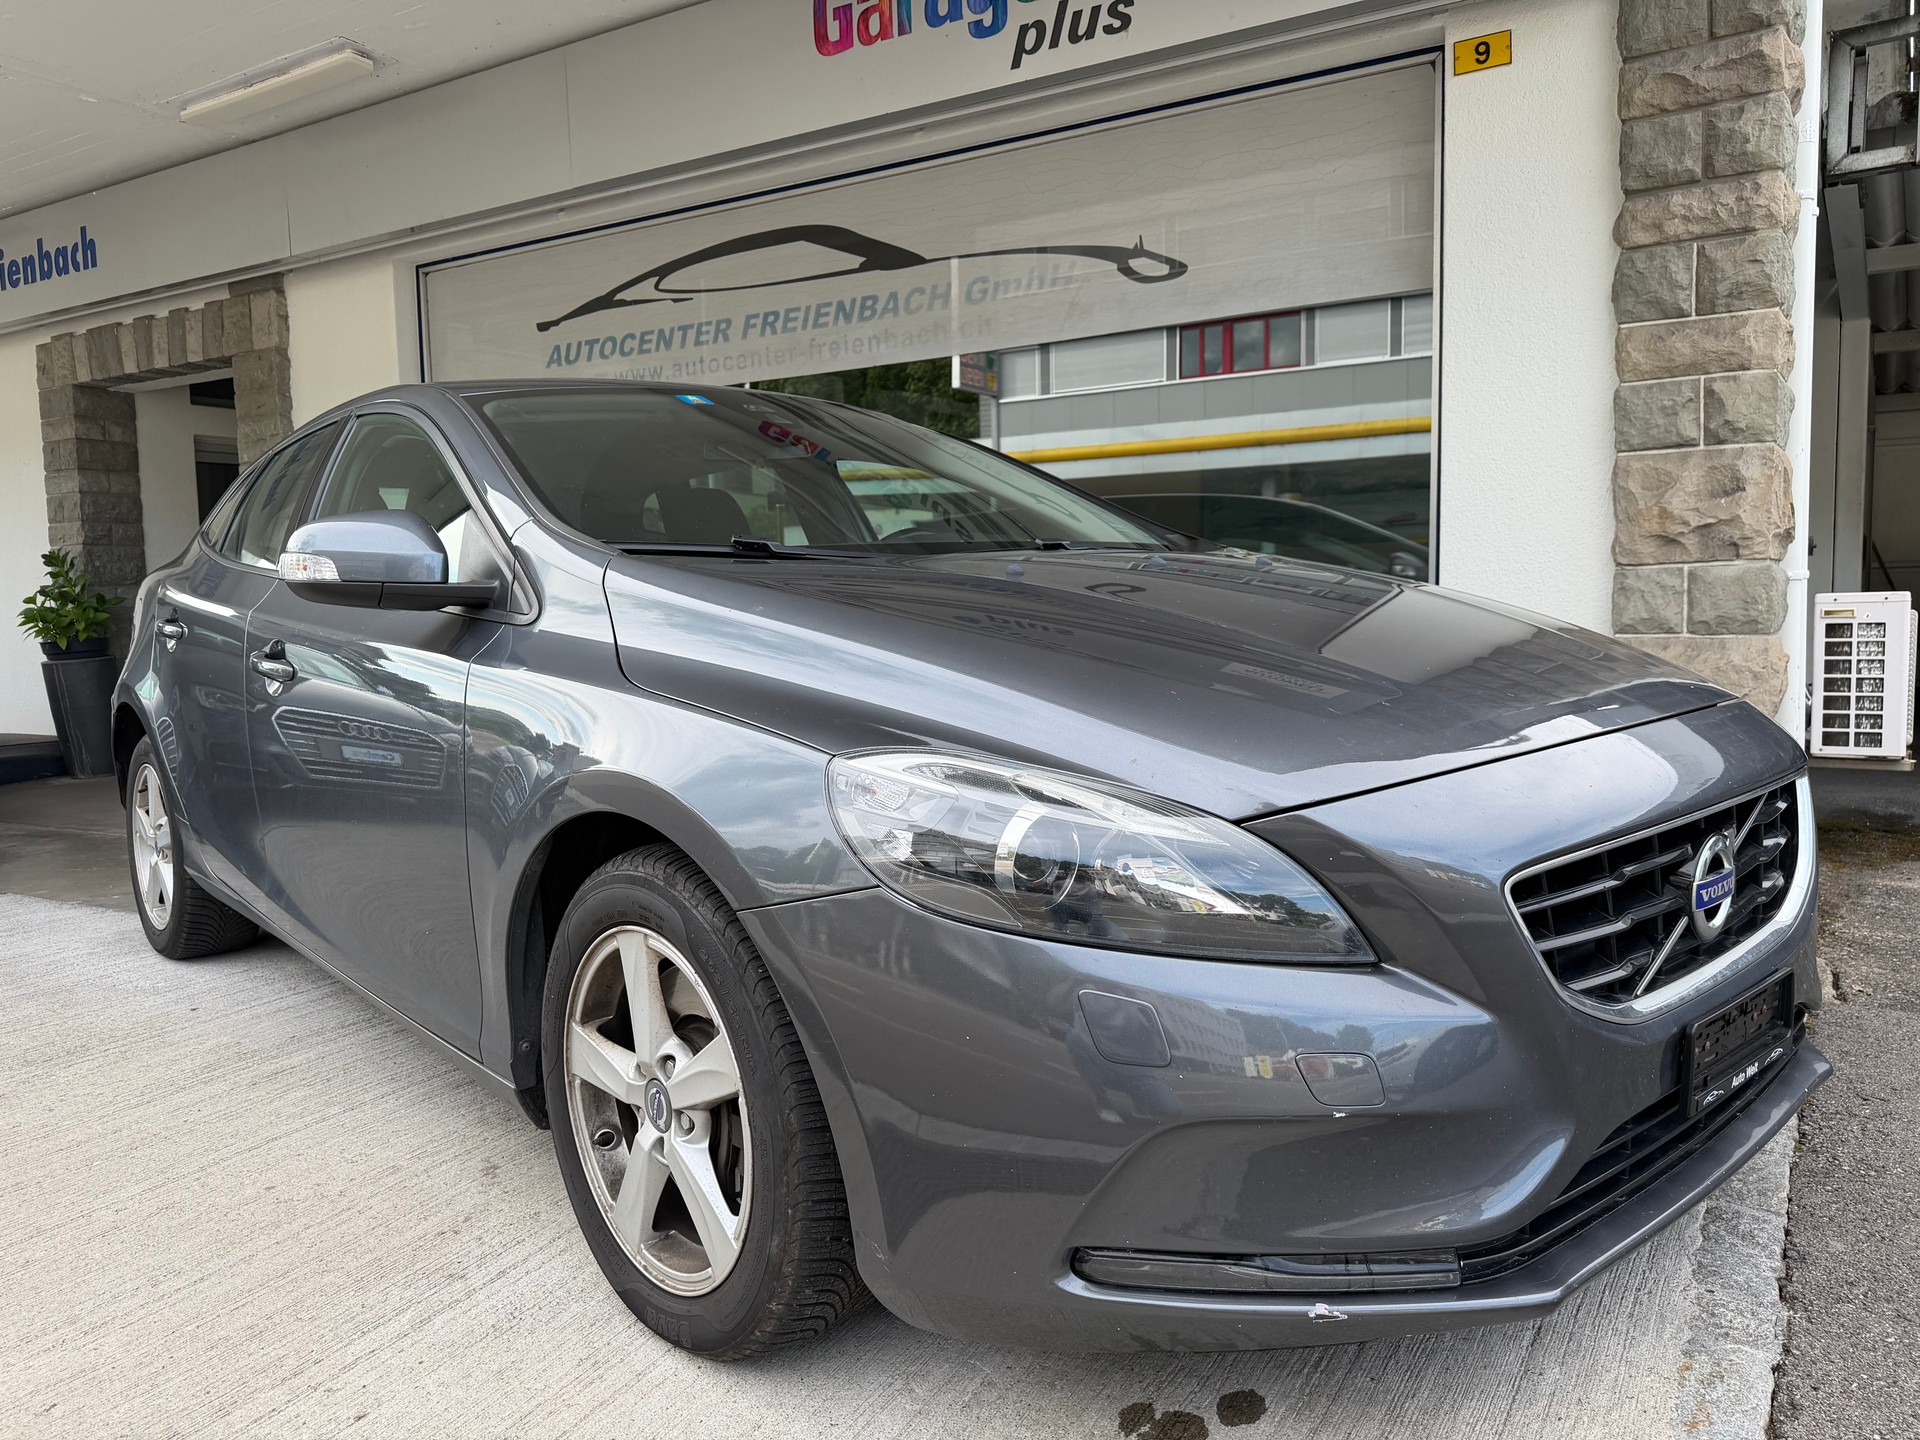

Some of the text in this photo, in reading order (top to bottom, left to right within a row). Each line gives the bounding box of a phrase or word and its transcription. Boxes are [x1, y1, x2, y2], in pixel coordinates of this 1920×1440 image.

[813, 0, 1037, 57] Garag
[1010, 0, 1134, 70] plus
[1475, 41, 1490, 64] 9
[546, 317, 732, 369] AUTOCENTER
[741, 281, 951, 341] FREIENBACH
[1699, 875, 1734, 902] VOLVO
[1731, 1072, 1746, 1089] Auto
